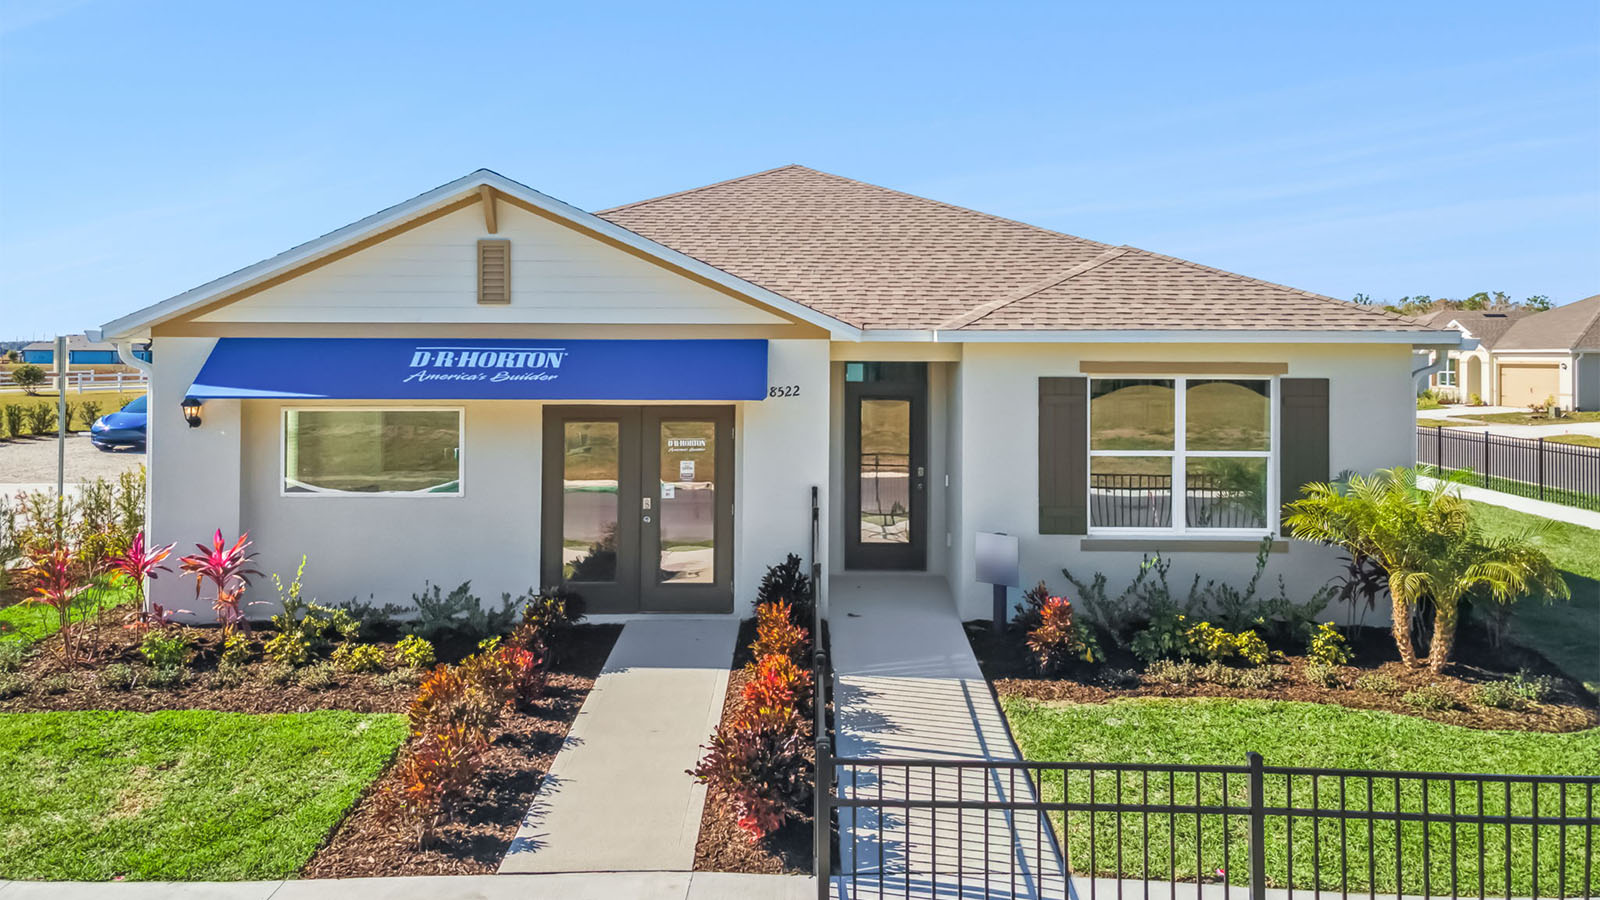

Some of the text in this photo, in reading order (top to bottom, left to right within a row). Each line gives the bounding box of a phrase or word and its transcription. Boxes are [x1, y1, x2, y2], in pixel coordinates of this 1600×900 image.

[403, 370, 558, 382] America's Builder
[769, 385, 800, 398] 8522
